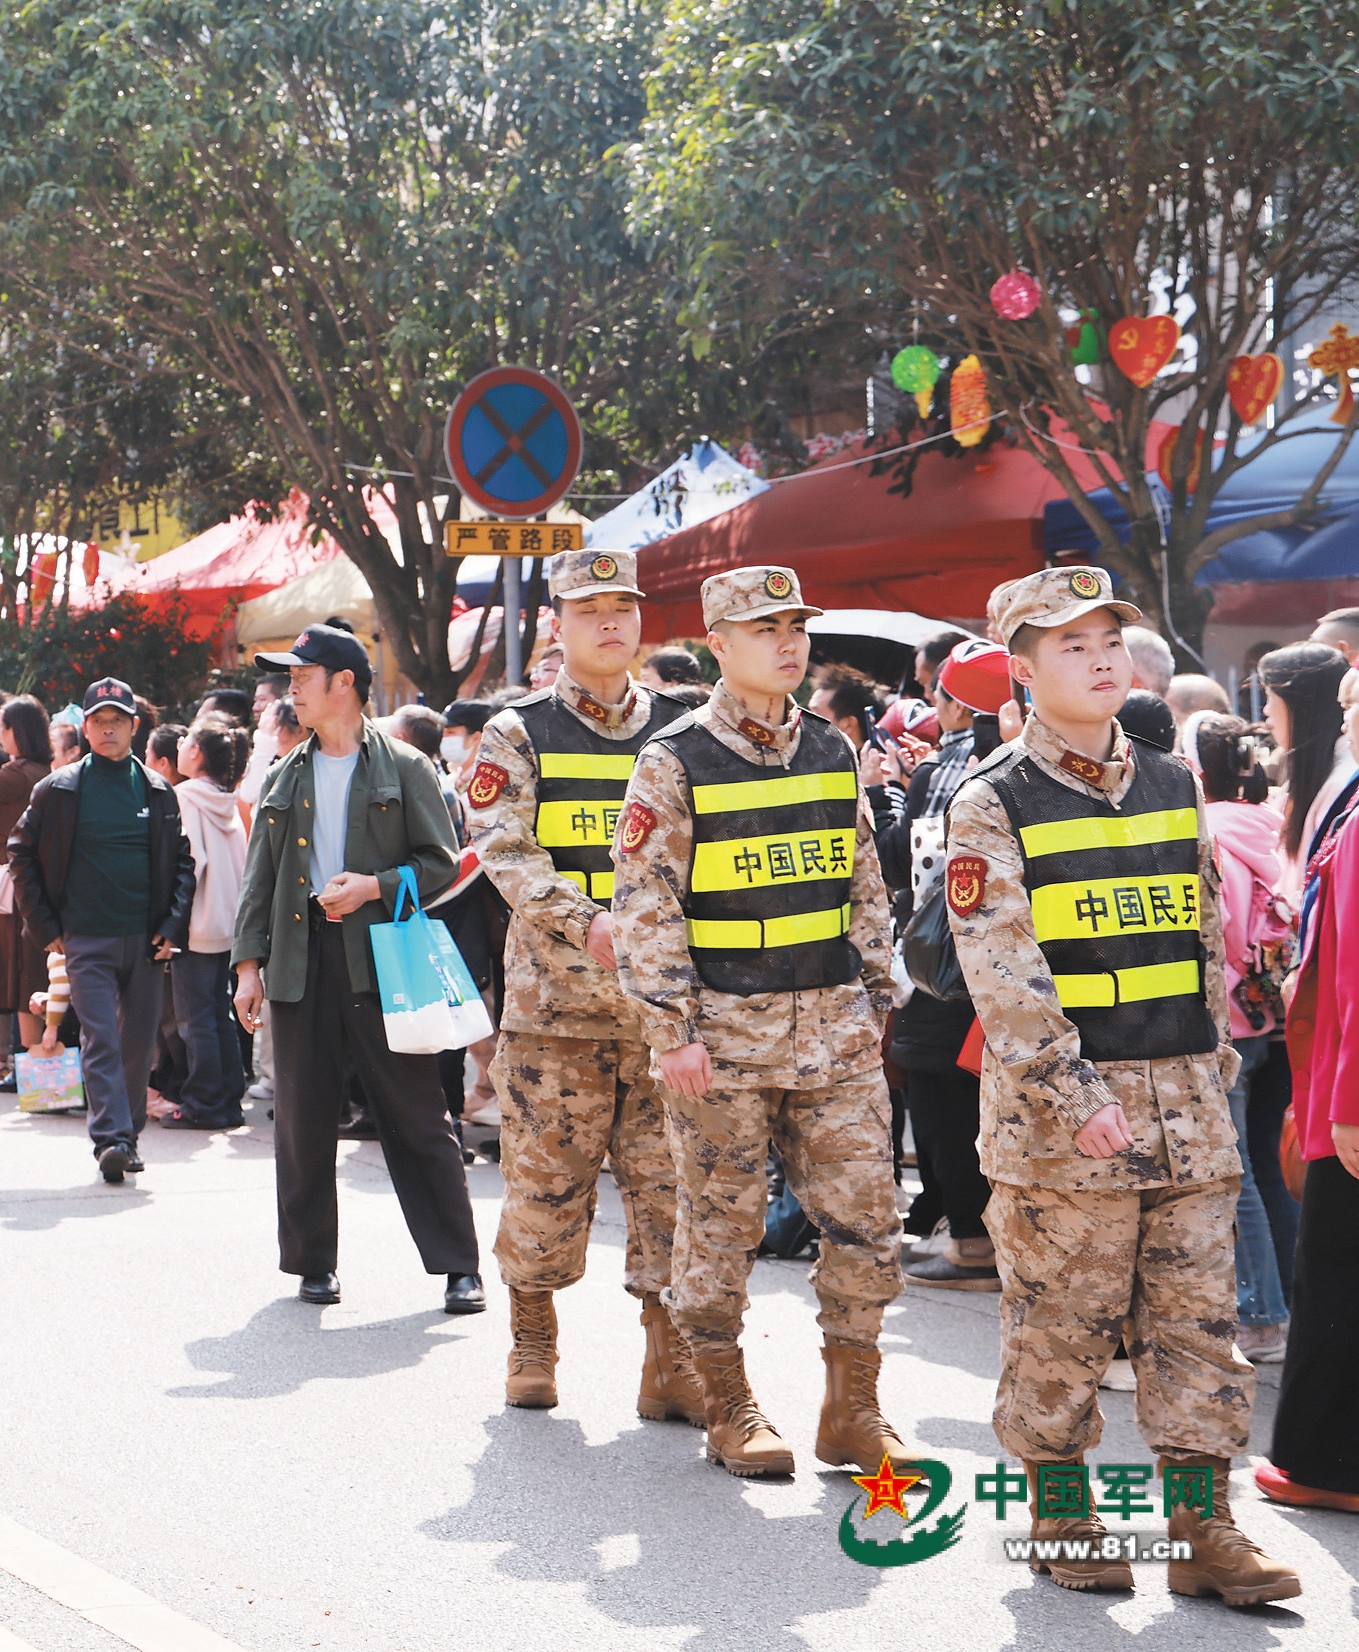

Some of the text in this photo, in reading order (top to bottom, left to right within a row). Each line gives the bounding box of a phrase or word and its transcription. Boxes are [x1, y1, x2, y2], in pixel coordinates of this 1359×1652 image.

[457, 527, 573, 550] 严管路段
[733, 837, 847, 883] 中国民兵
[950, 861, 980, 872] 中国民兵
[1075, 884, 1198, 932] 中国民兵
